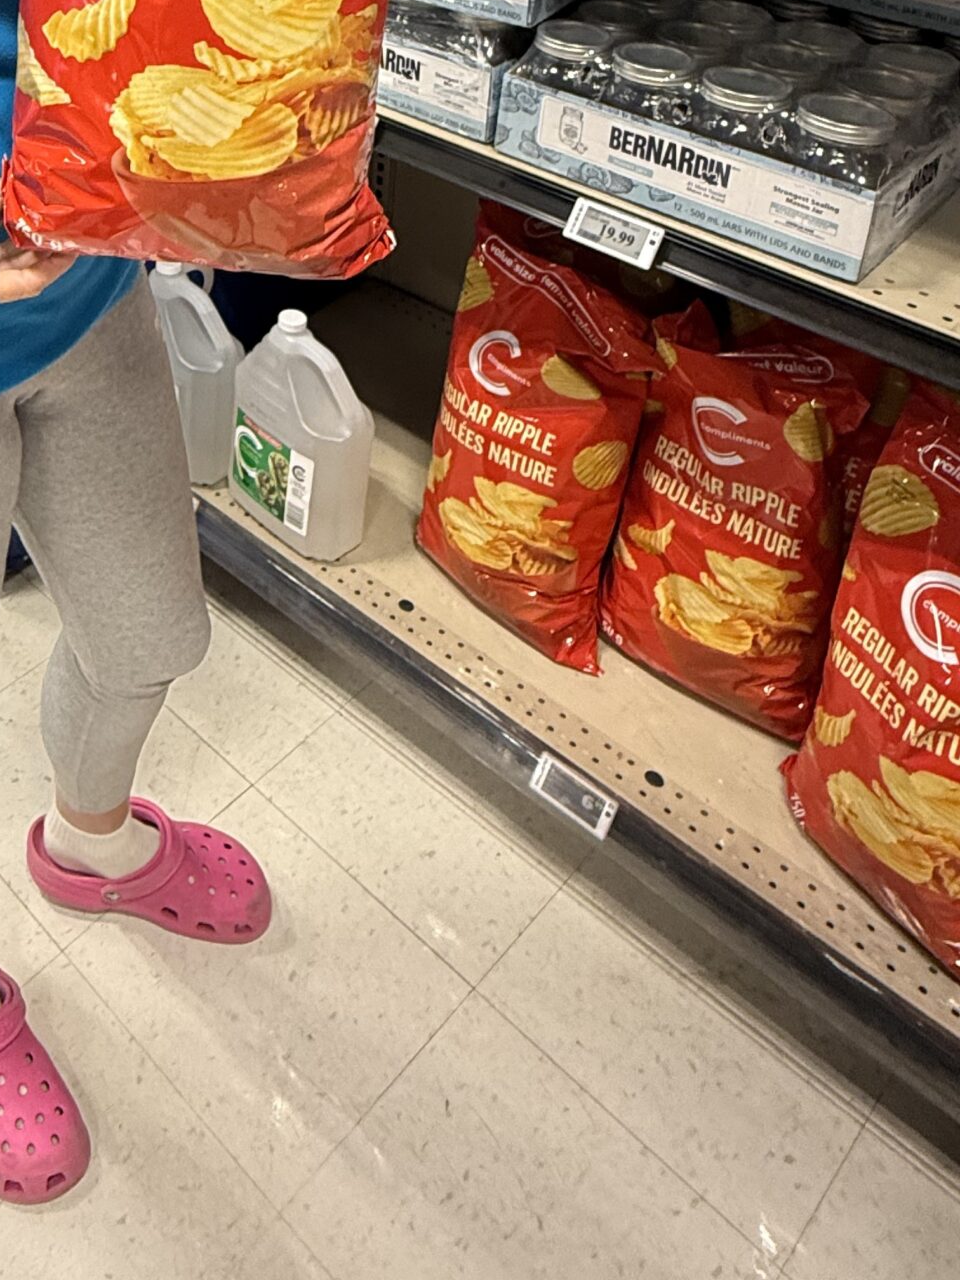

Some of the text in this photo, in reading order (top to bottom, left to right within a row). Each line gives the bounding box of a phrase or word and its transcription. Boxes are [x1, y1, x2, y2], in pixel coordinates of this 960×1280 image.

[380, 48, 421, 81] RDIN
[609, 126, 732, 188] BERNARDIN
[774, 186, 840, 214] Strongest Sealing
[785, 197, 824, 215] Mason Jar
[598, 223, 635, 247] 19.99
[674, 202, 682, 211] 12
[690, 210, 705, 220] 500
[722, 218, 743, 233] JARS
[745, 228, 767, 242] WITH
[769, 235, 788, 250] LIDS
[790, 244, 811, 258] AND
[813, 253, 846, 271] BANDS
[490, 242, 514, 267] value
[514, 264, 536, 282] size
[492, 411, 557, 457] RIPPLE
[700, 422, 771, 451] compliments
[488, 441, 558, 488] NATURE
[654, 435, 725, 496] REGULAR
[732, 482, 802, 528] RIPPLE
[643, 460, 803, 559] ONDULÉES NATURE
[832, 639, 906, 730] NDULÉES
[841, 607, 960, 724] REGULAR RIP
